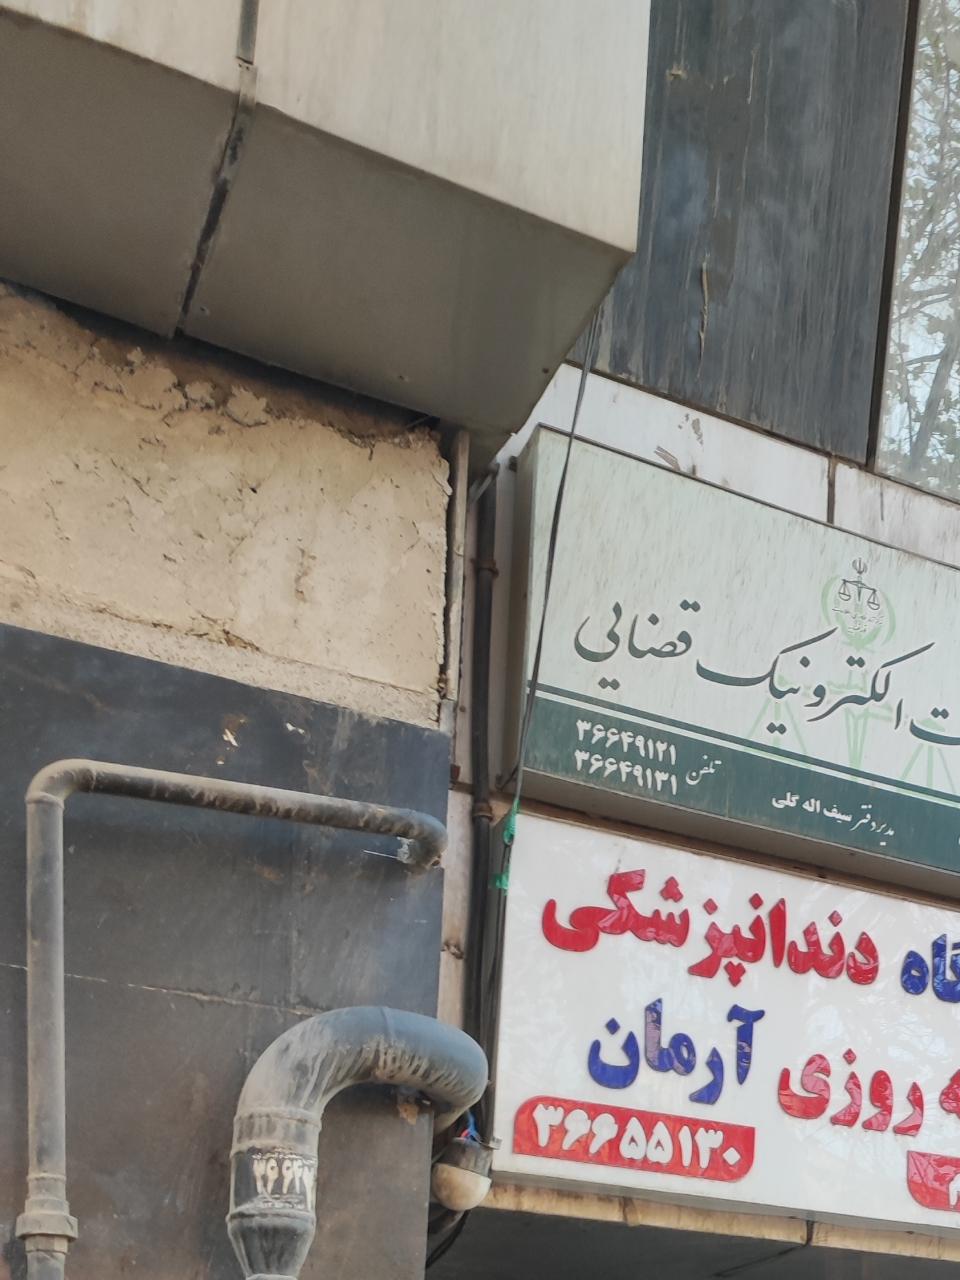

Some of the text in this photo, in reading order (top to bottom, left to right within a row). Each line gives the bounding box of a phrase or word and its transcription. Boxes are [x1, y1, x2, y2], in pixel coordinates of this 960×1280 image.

[696, 626, 935, 735] الکترونیک
[574, 749, 678, 795] ۳۶۶۴۹۱۳۱
[575, 719, 722, 786] تلفن ۳۶۶۴۹۱۲۱
[771, 791, 799, 809] گلی
[802, 798, 820, 813] اله
[822, 804, 853, 823] سیف
[849, 804, 876, 831] دفتر
[541, 868, 879, 987] دندانپزشکی
[587, 998, 766, 1106] آرمان
[777, 1047, 925, 1137] روزی
[532, 1103, 741, 1169] ۳۶۶۵۵۱۳۰
